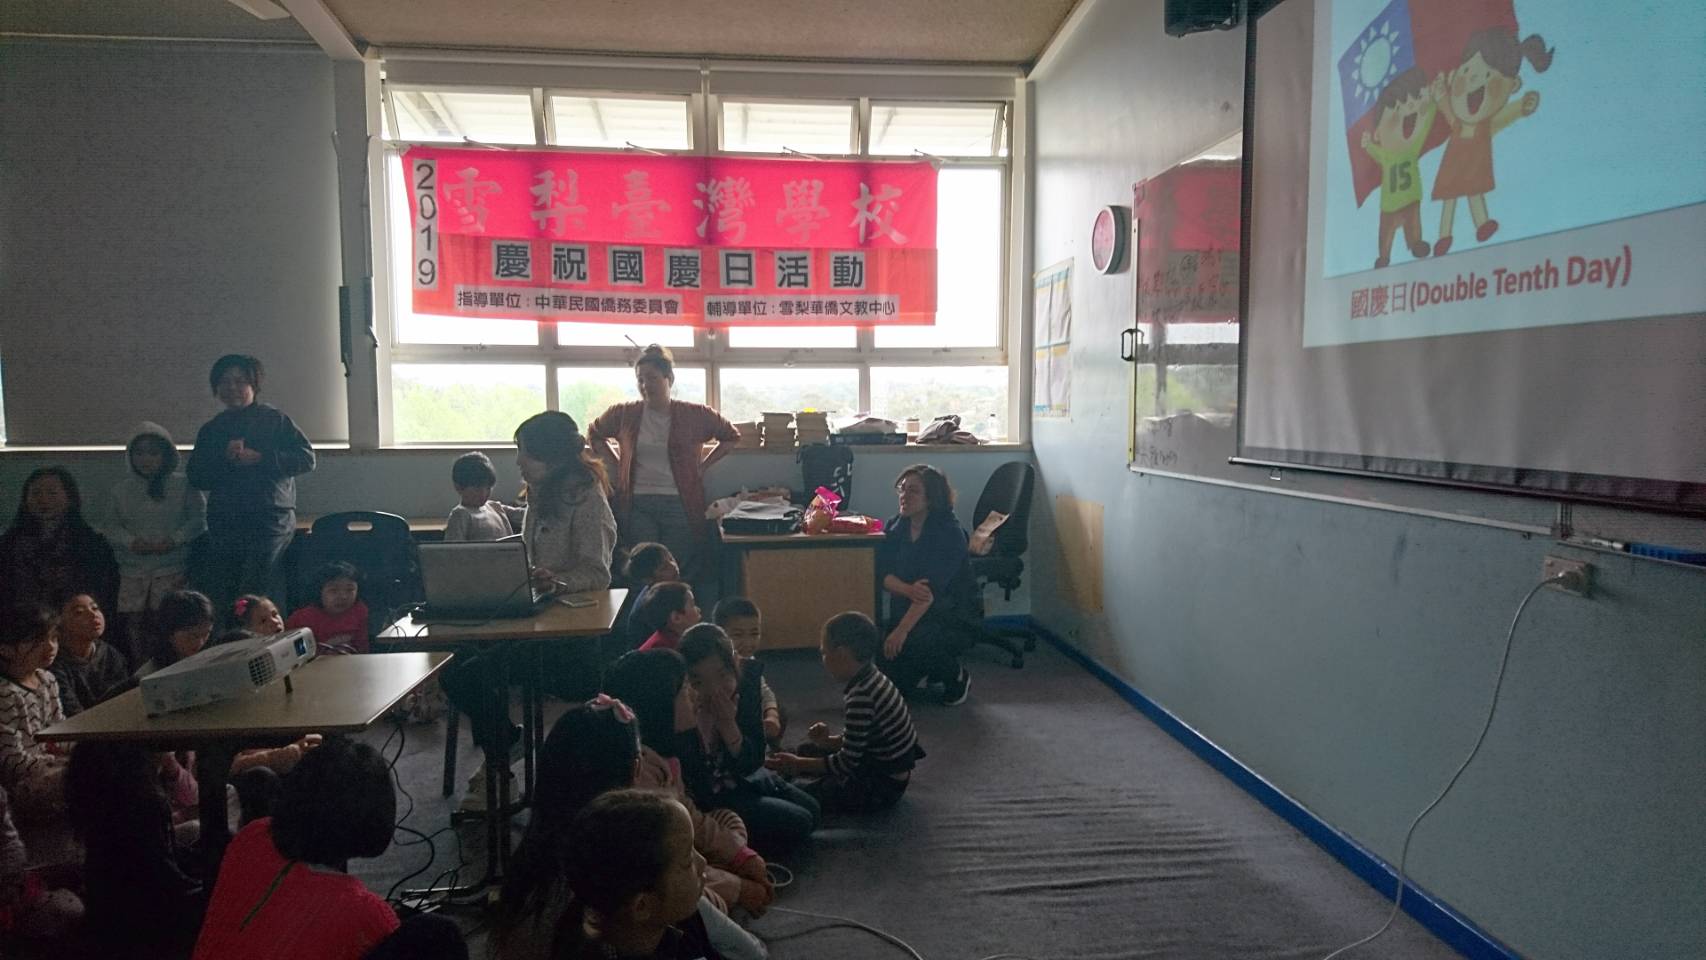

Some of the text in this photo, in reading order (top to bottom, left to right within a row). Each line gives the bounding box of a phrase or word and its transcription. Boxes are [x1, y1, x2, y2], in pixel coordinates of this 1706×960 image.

[1389, 159, 1412, 194] 15
[415, 163, 437, 286] 2019
[443, 166, 909, 245] 雪梨臺灣學校
[495, 243, 864, 289] 慶祝國慶日活動
[1493, 257, 1559, 296] Tenth
[1566, 244, 1632, 288] Day)
